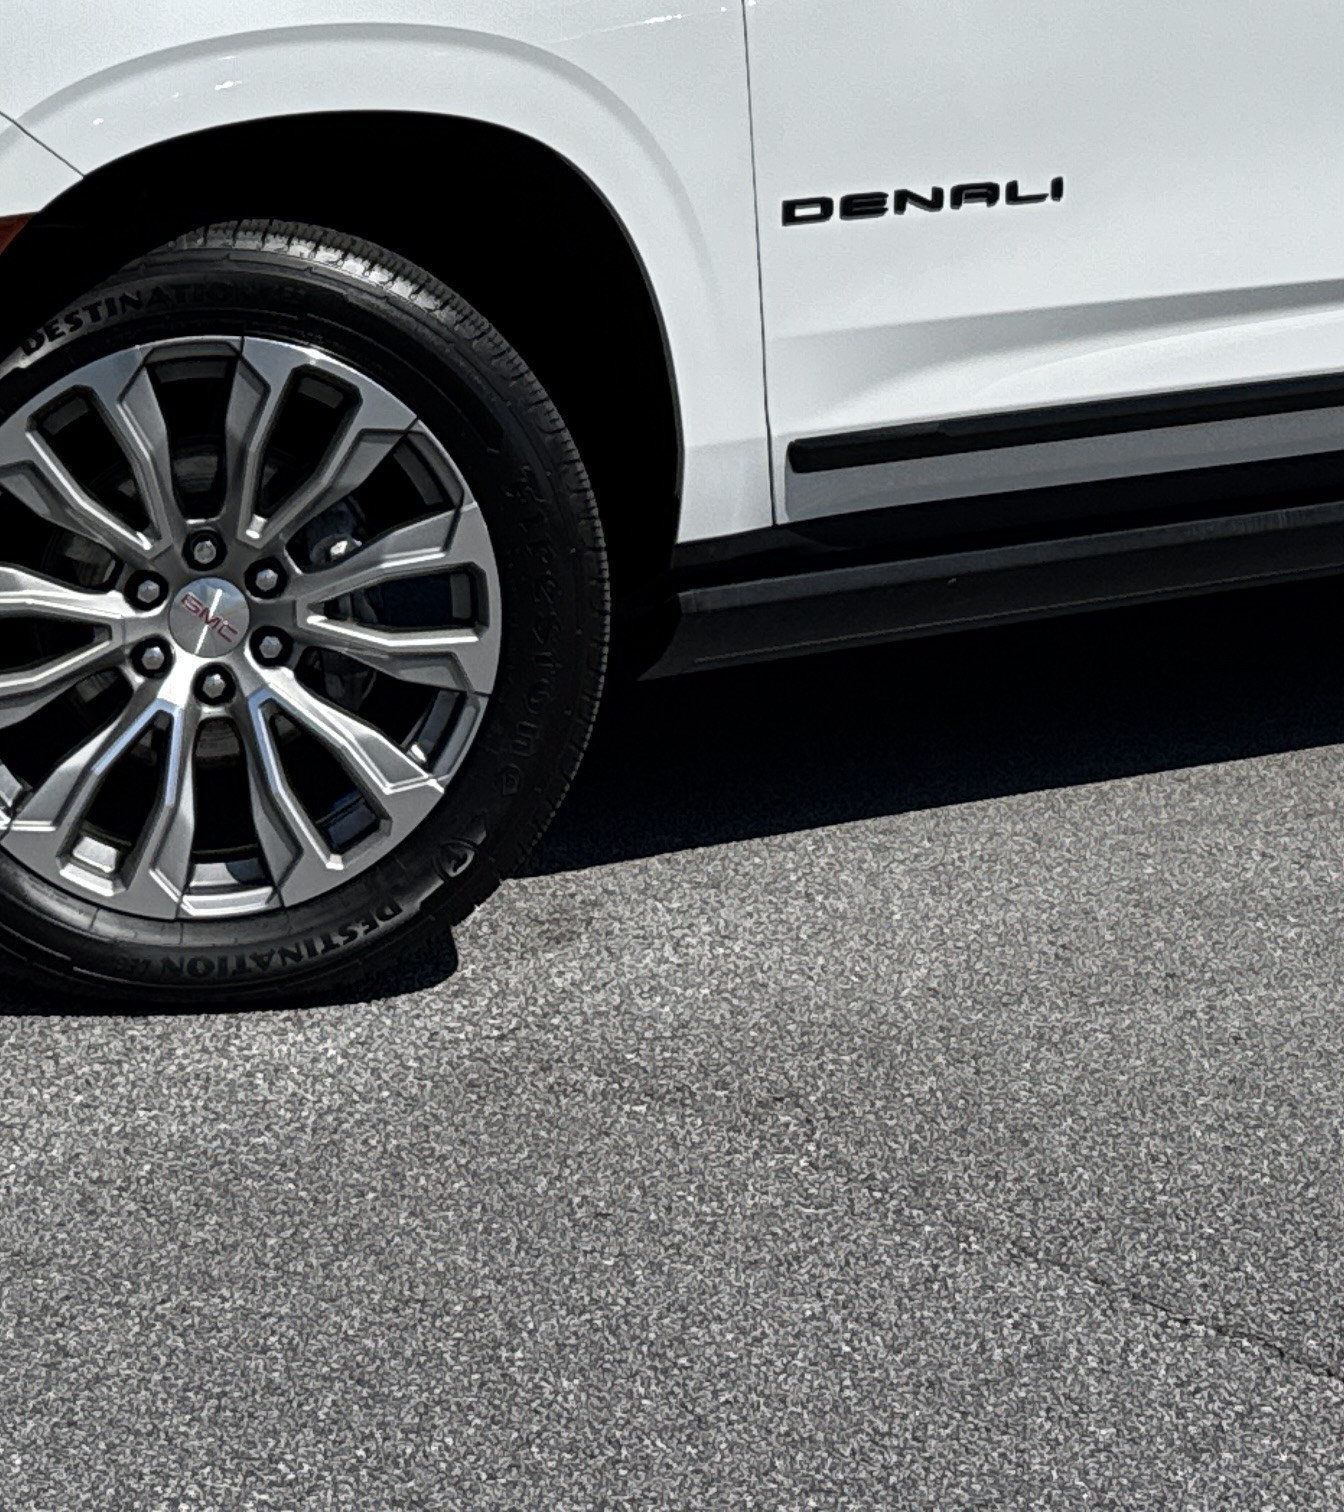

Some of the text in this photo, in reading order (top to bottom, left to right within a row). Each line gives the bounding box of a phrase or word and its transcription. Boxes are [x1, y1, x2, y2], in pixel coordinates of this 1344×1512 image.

[781, 175, 1065, 227] DENALI
[179, 591, 239, 643] GMC
[160, 895, 404, 978] DESTINATION
